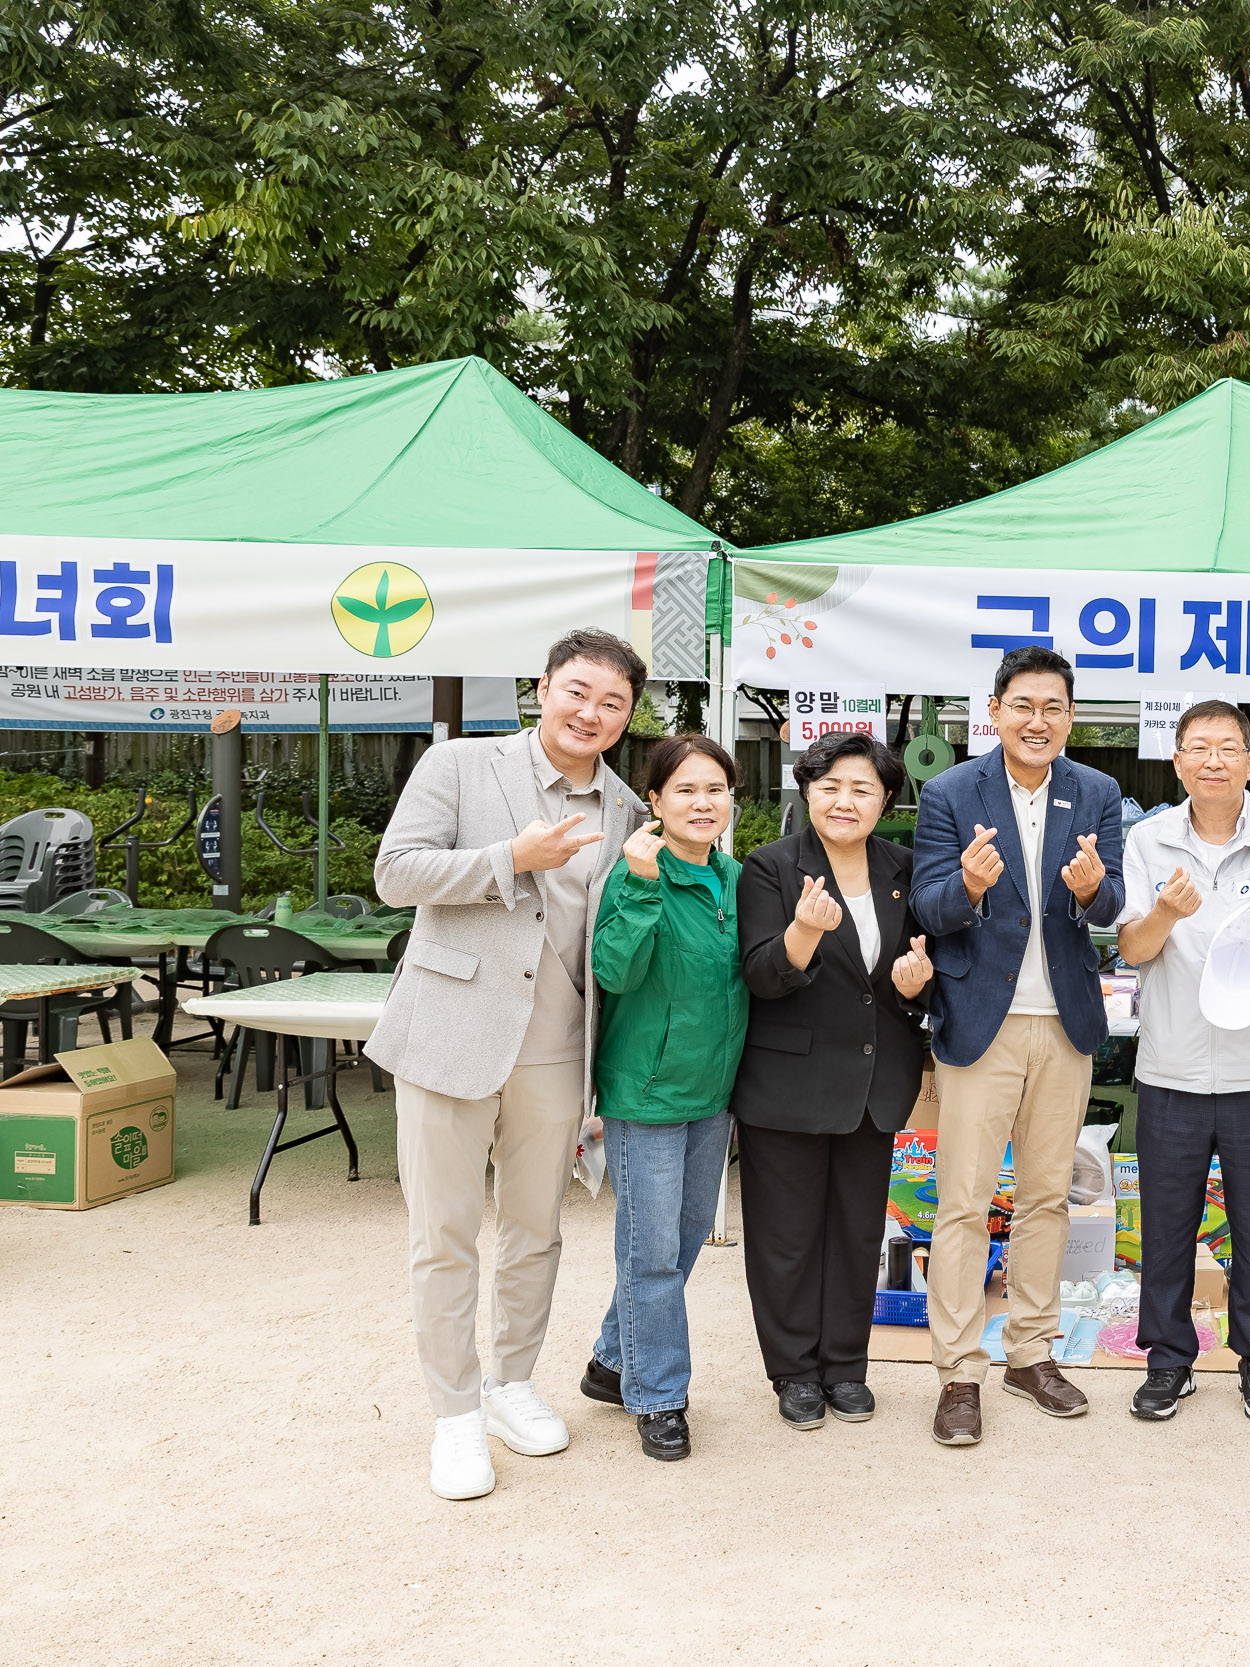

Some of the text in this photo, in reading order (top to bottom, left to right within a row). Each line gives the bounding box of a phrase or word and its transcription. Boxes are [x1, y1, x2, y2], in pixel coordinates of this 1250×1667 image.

[0, 560, 173, 643] 녀회
[11, 683, 41, 698] 공원
[45, 684, 60, 699] 내
[130, 686, 160, 701] 음주
[164, 687, 178, 702] 및
[182, 687, 255, 703] 소란행위를
[259, 688, 289, 703] 삼가
[340, 687, 402, 702] 바랍니다.
[842, 698, 881, 713] 10켤레
[169, 709, 212, 720] 광진구청
[1144, 719, 1166, 729] 카카오
[904, 1154, 933, 1165] Train
[917, 1211, 936, 1219] 4.6m
